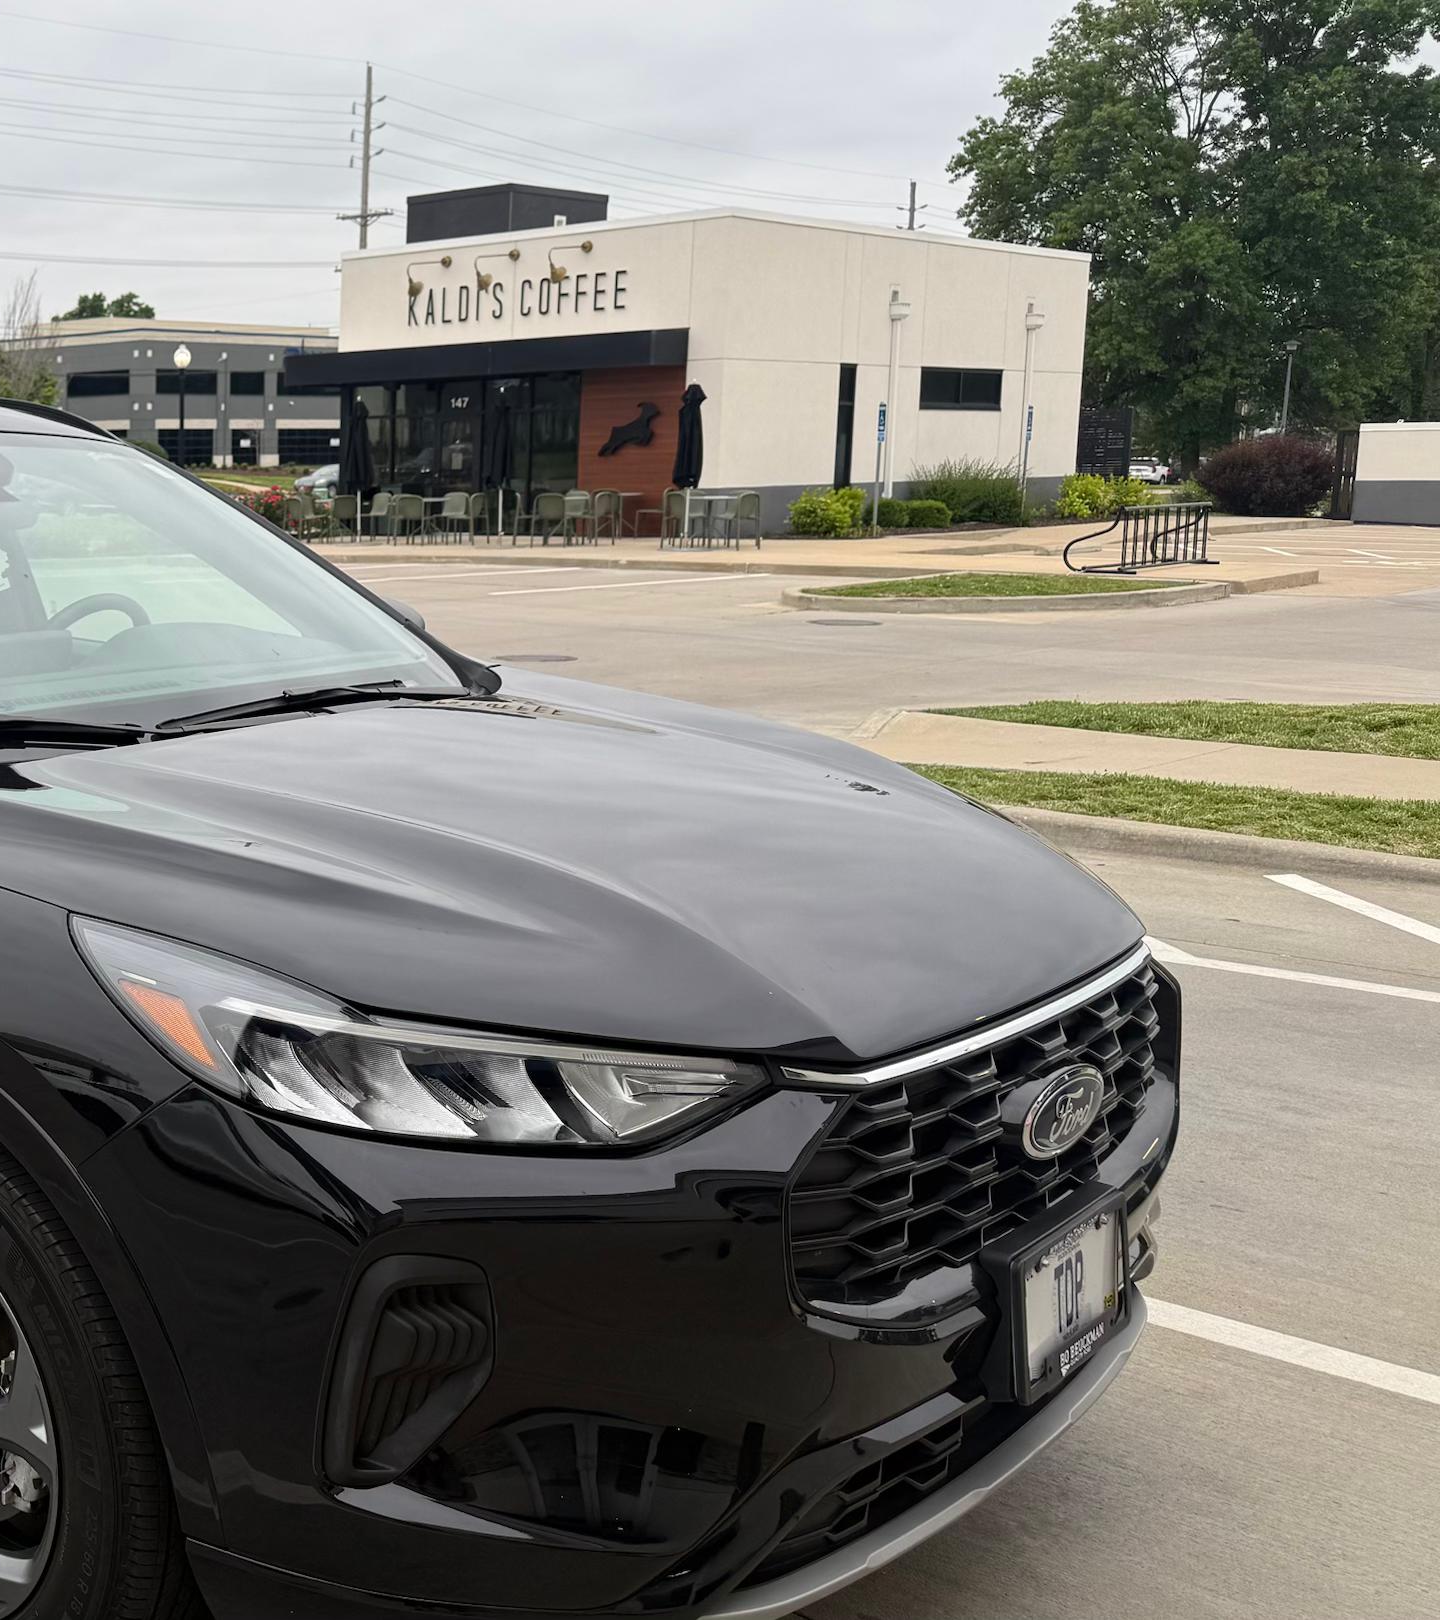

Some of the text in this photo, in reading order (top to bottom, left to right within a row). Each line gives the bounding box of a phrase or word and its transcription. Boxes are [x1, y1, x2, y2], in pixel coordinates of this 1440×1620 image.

[520, 270, 628, 317] COFFEE
[450, 396, 470, 409] 147
[1049, 1087, 1094, 1143] Ford
